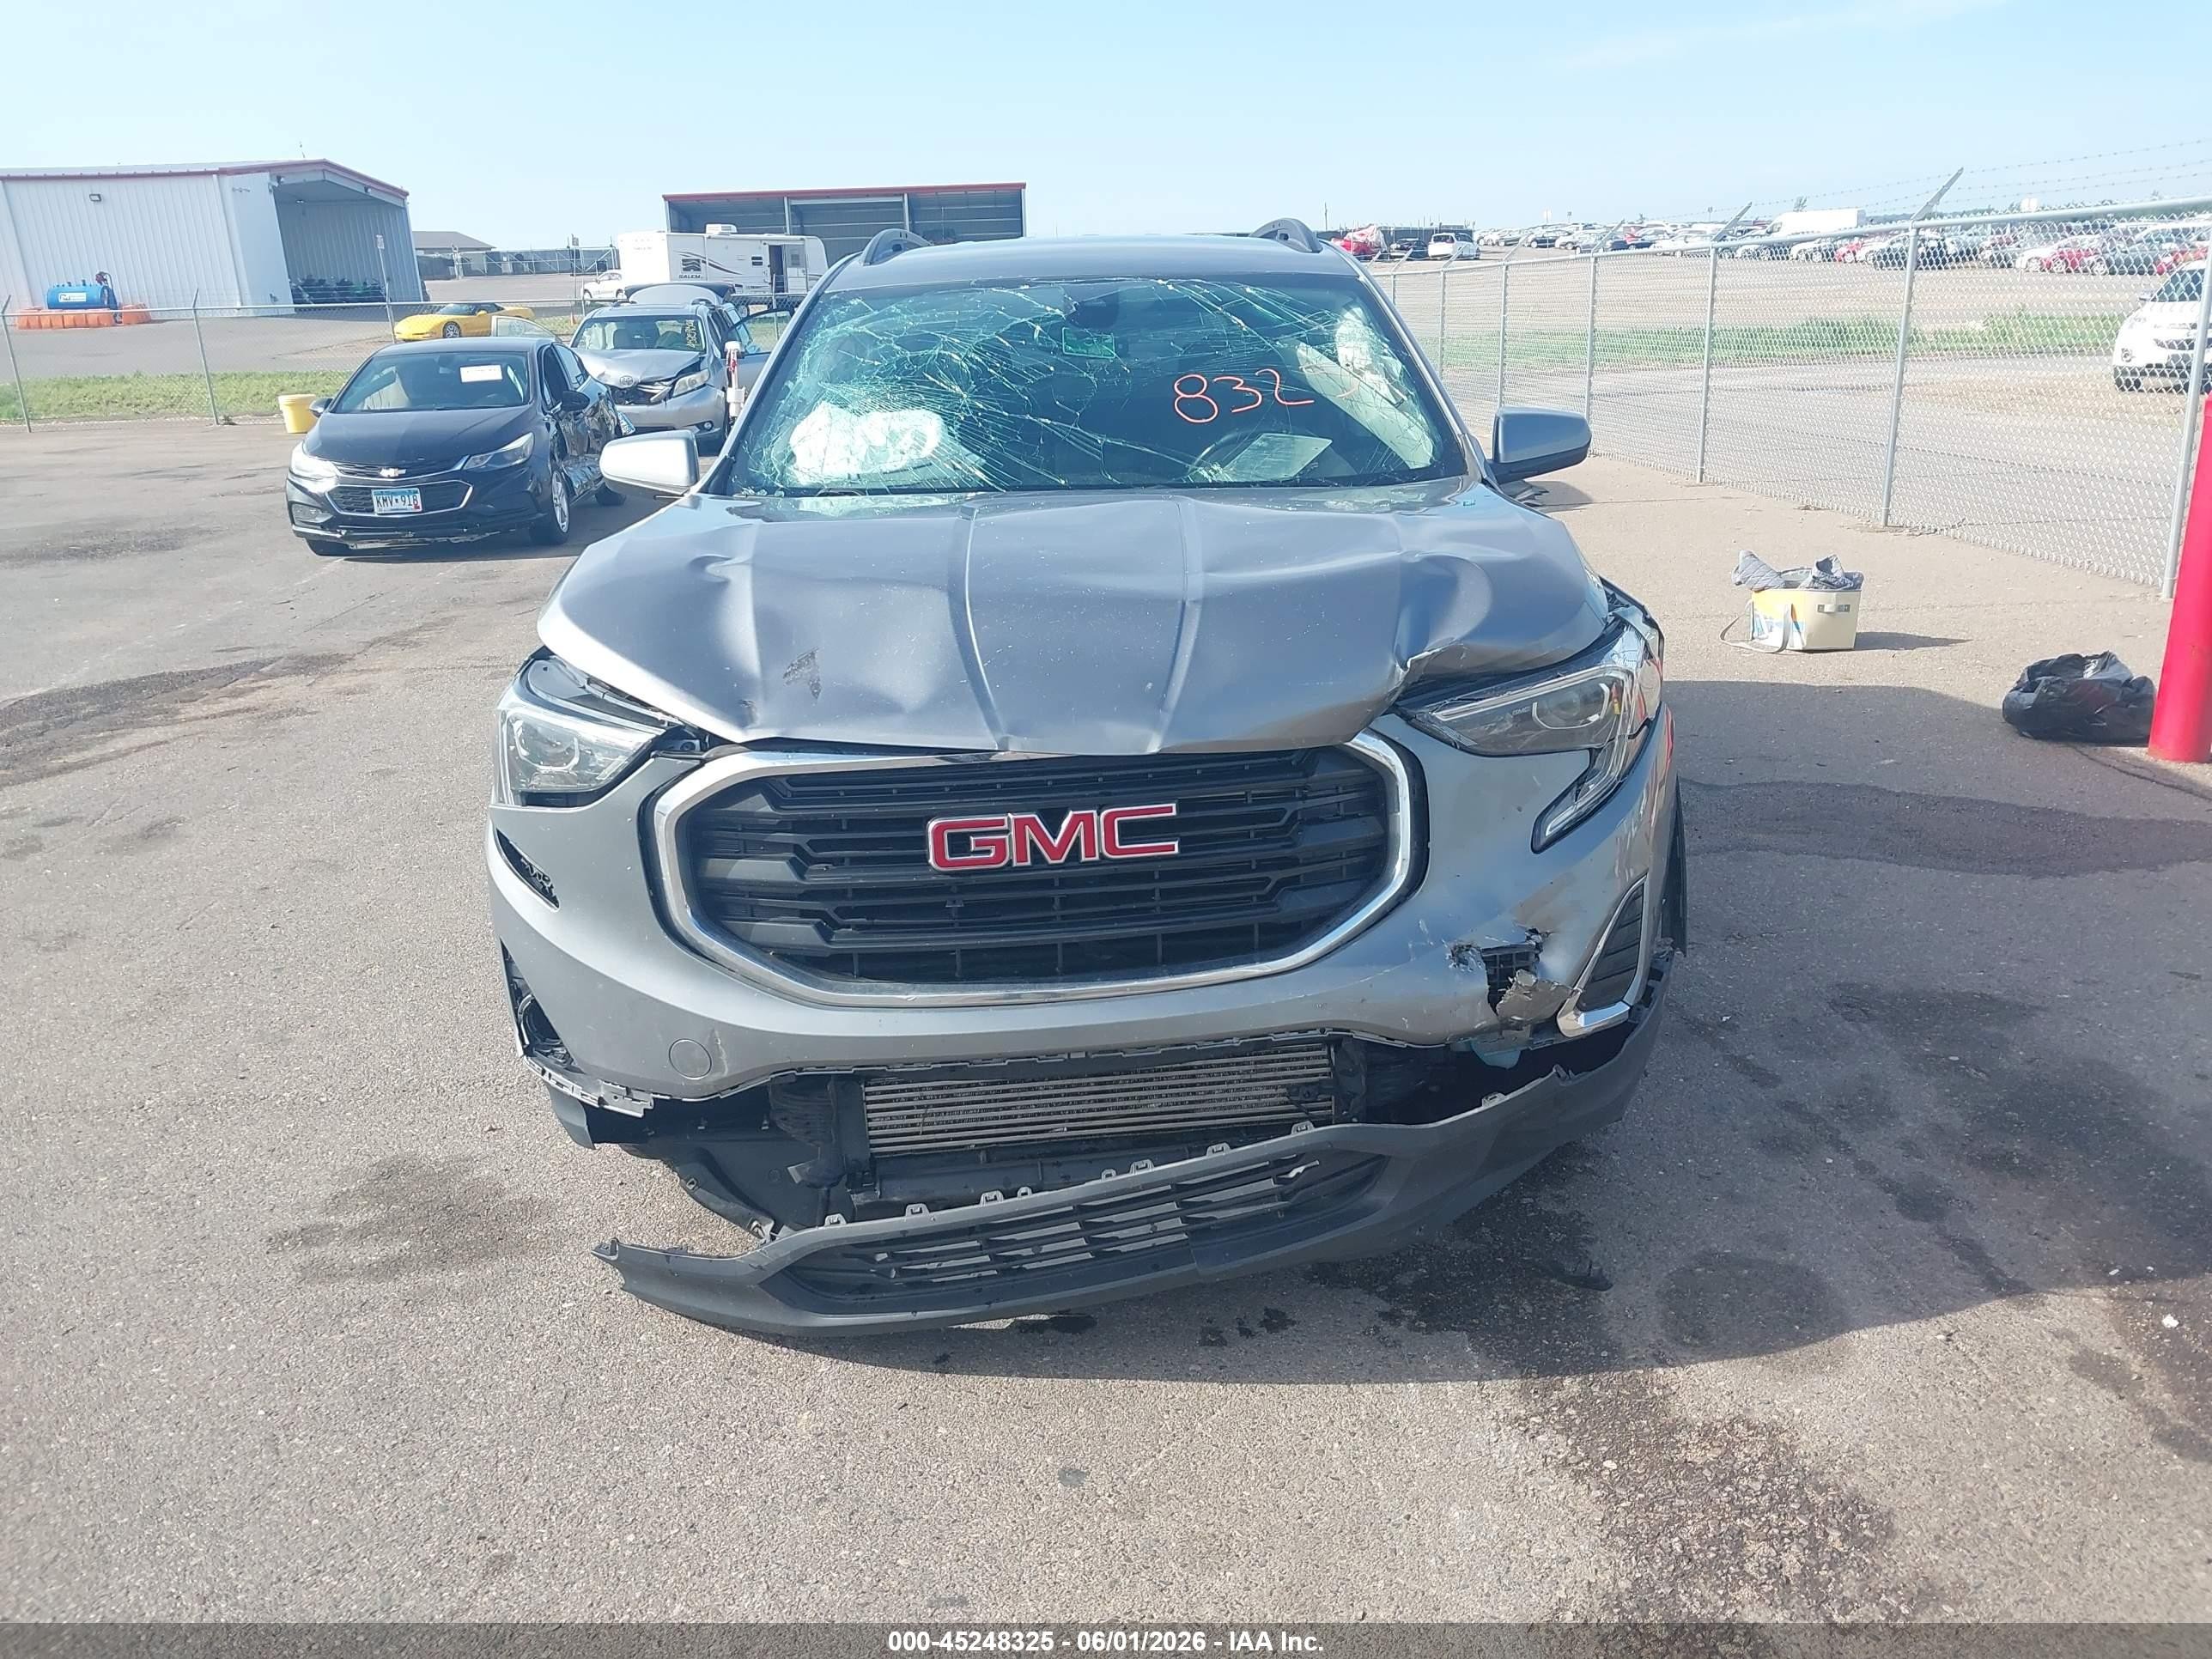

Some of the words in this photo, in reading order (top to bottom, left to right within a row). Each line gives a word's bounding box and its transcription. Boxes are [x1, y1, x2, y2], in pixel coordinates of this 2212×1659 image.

[1174, 368, 1316, 423] 832
[376, 495, 393, 507] KMV
[1511, 706, 1530, 715] GMC
[928, 803, 1179, 872] GMC
